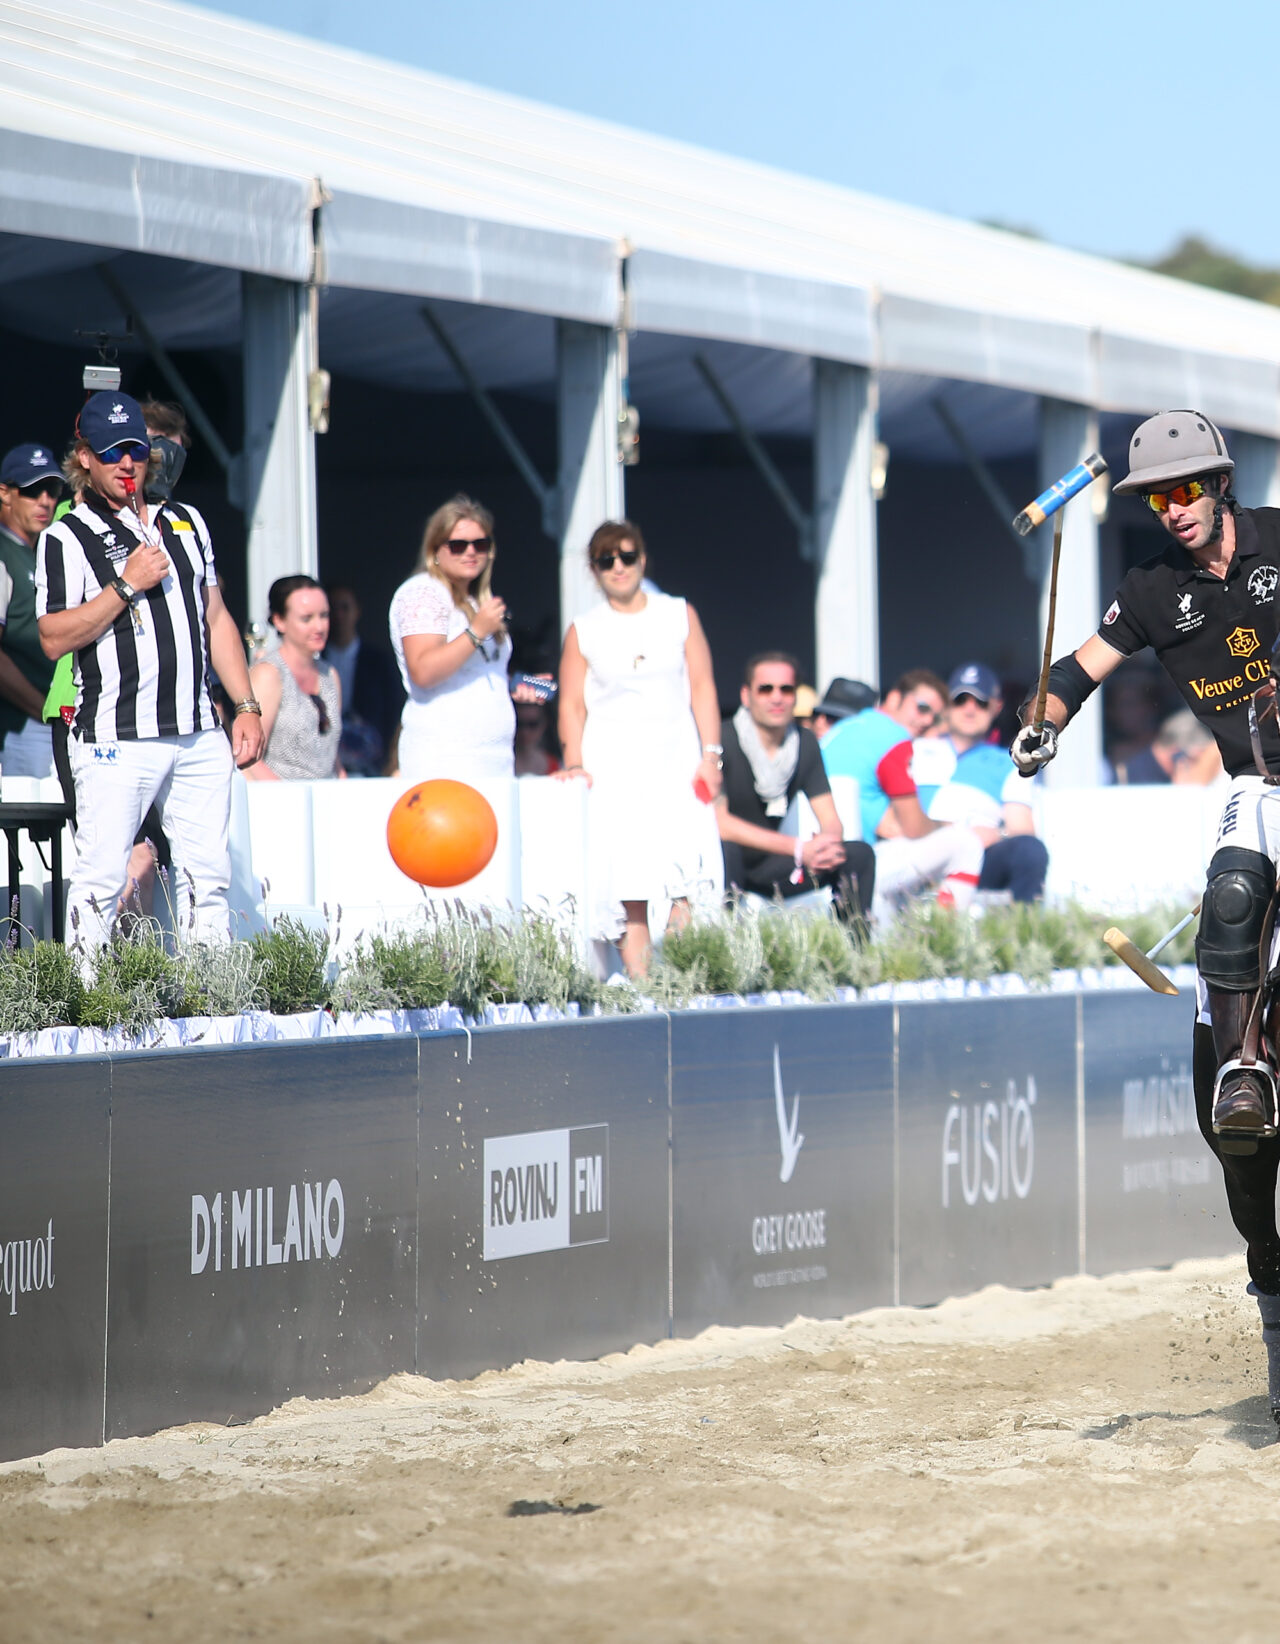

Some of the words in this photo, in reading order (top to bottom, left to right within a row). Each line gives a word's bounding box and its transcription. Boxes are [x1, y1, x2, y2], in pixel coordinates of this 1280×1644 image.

[1188, 675, 1244, 700] Veuve
[1244, 659, 1271, 682] Cli
[490, 1161, 558, 1228] ROVINJ
[575, 1155, 603, 1215] FM
[191, 1192, 222, 1275] D1
[231, 1178, 345, 1270] MILANO
[752, 1215, 784, 1255] GREY
[785, 1209, 827, 1252] GOOSE
